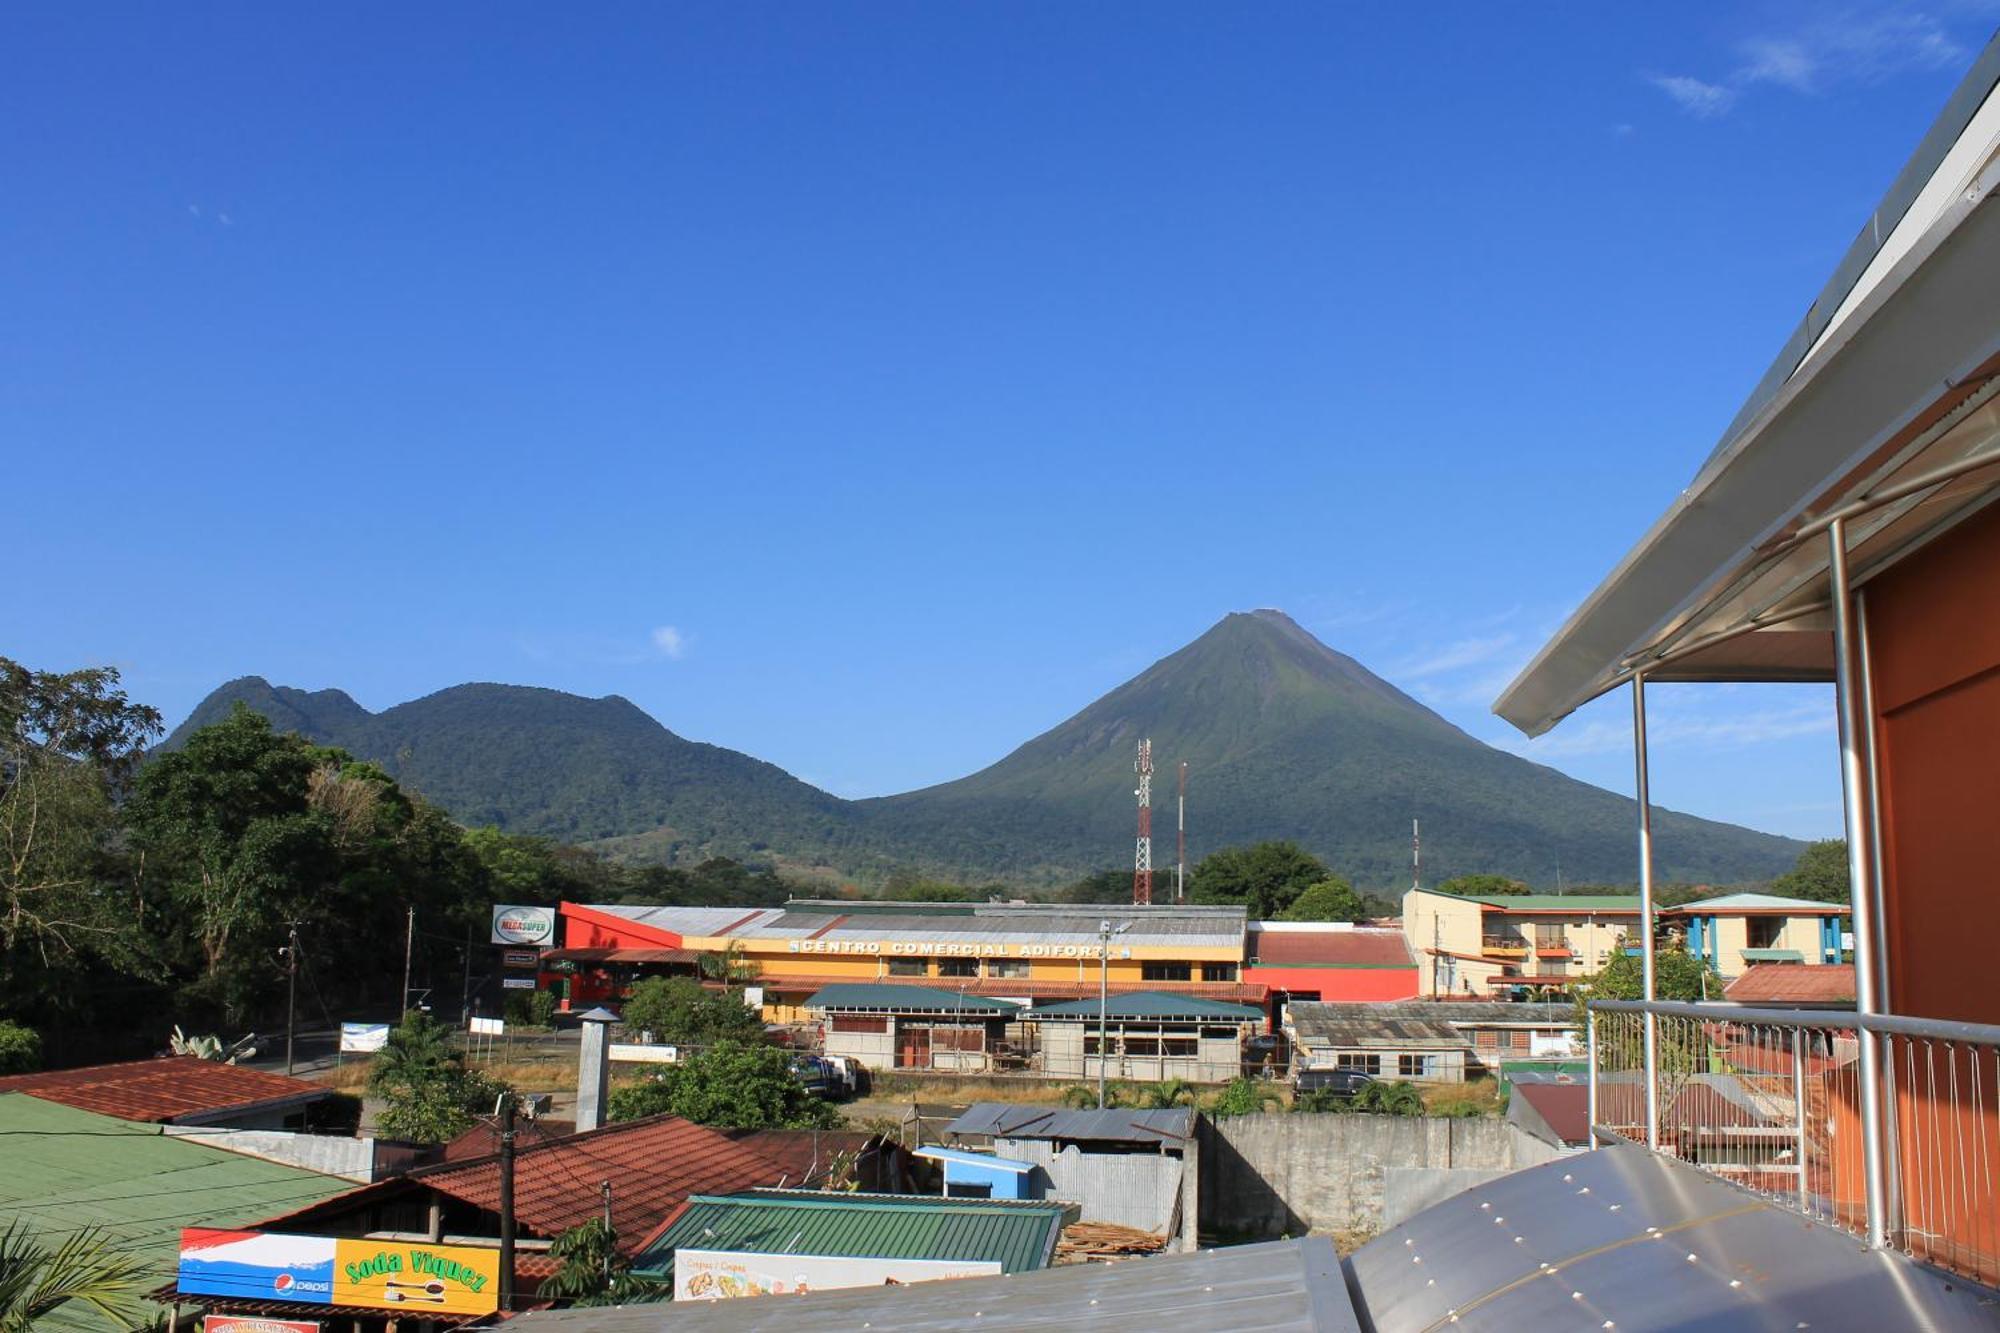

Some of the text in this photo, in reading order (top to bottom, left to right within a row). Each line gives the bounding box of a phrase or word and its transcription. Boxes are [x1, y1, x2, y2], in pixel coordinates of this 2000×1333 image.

[501, 920, 546, 932] MEGASUPER
[802, 940, 880, 954] CENTRO
[892, 943, 1009, 957] COMERCIAL
[345, 1251, 403, 1284] Soda
[293, 1281, 329, 1292] pepsi
